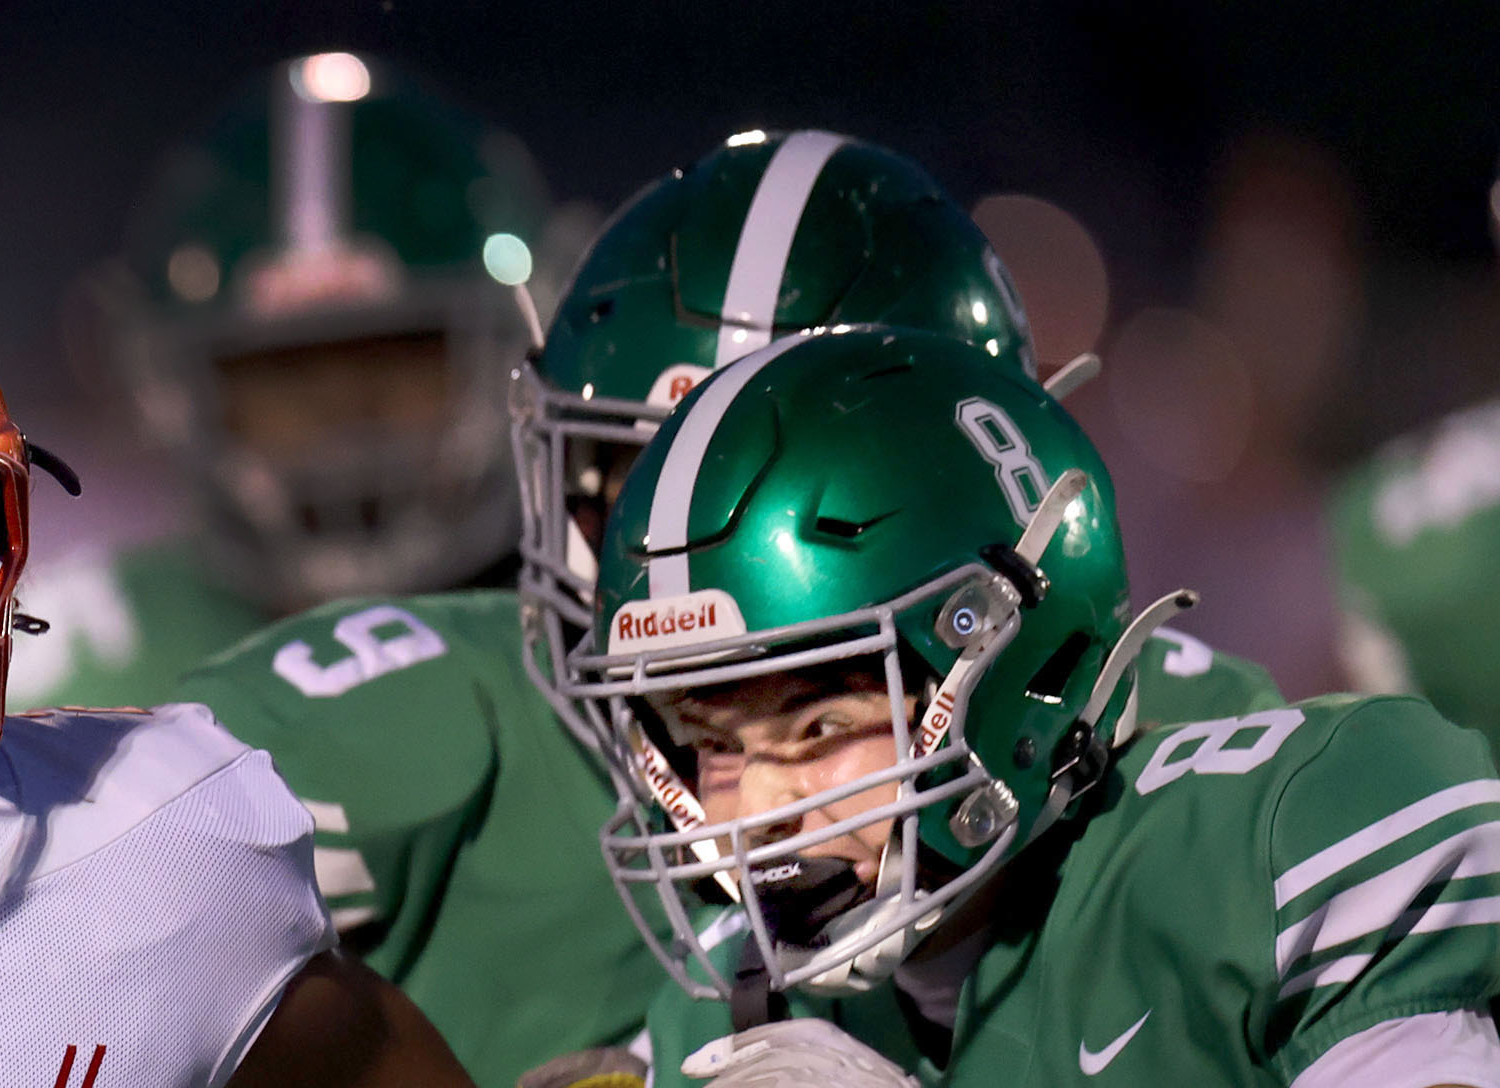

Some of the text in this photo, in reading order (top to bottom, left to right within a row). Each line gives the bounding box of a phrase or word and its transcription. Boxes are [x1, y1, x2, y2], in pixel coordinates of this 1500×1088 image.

[953, 396, 1049, 530] 8
[618, 602, 717, 641] Riddell
[1135, 708, 1306, 796] 8
